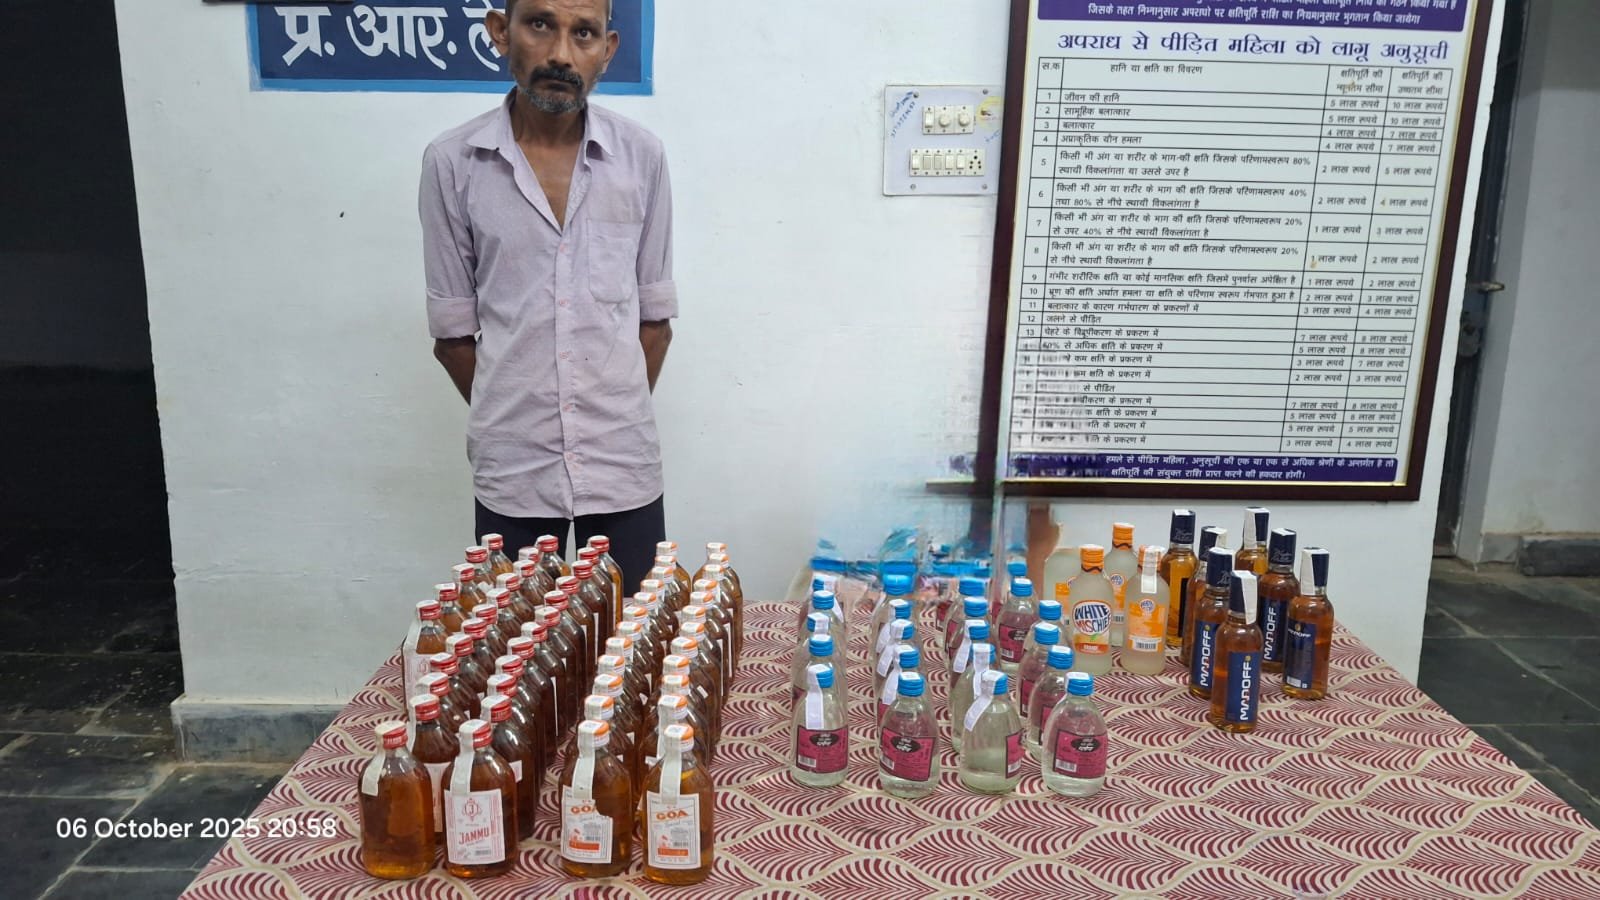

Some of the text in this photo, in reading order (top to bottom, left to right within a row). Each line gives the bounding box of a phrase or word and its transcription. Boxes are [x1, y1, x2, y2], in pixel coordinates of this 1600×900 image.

[274, 6, 336, 67] प्र.
[346, 5, 458, 71] आर.
[1058, 30, 1447, 63] अपराध से पीड़ित महिला को लागू अनुसूची
[1075, 605, 1109, 620] WHITE
[570, 805, 595, 815] GO
[656, 809, 689, 821] GOA
[459, 827, 490, 845] JAMMU
